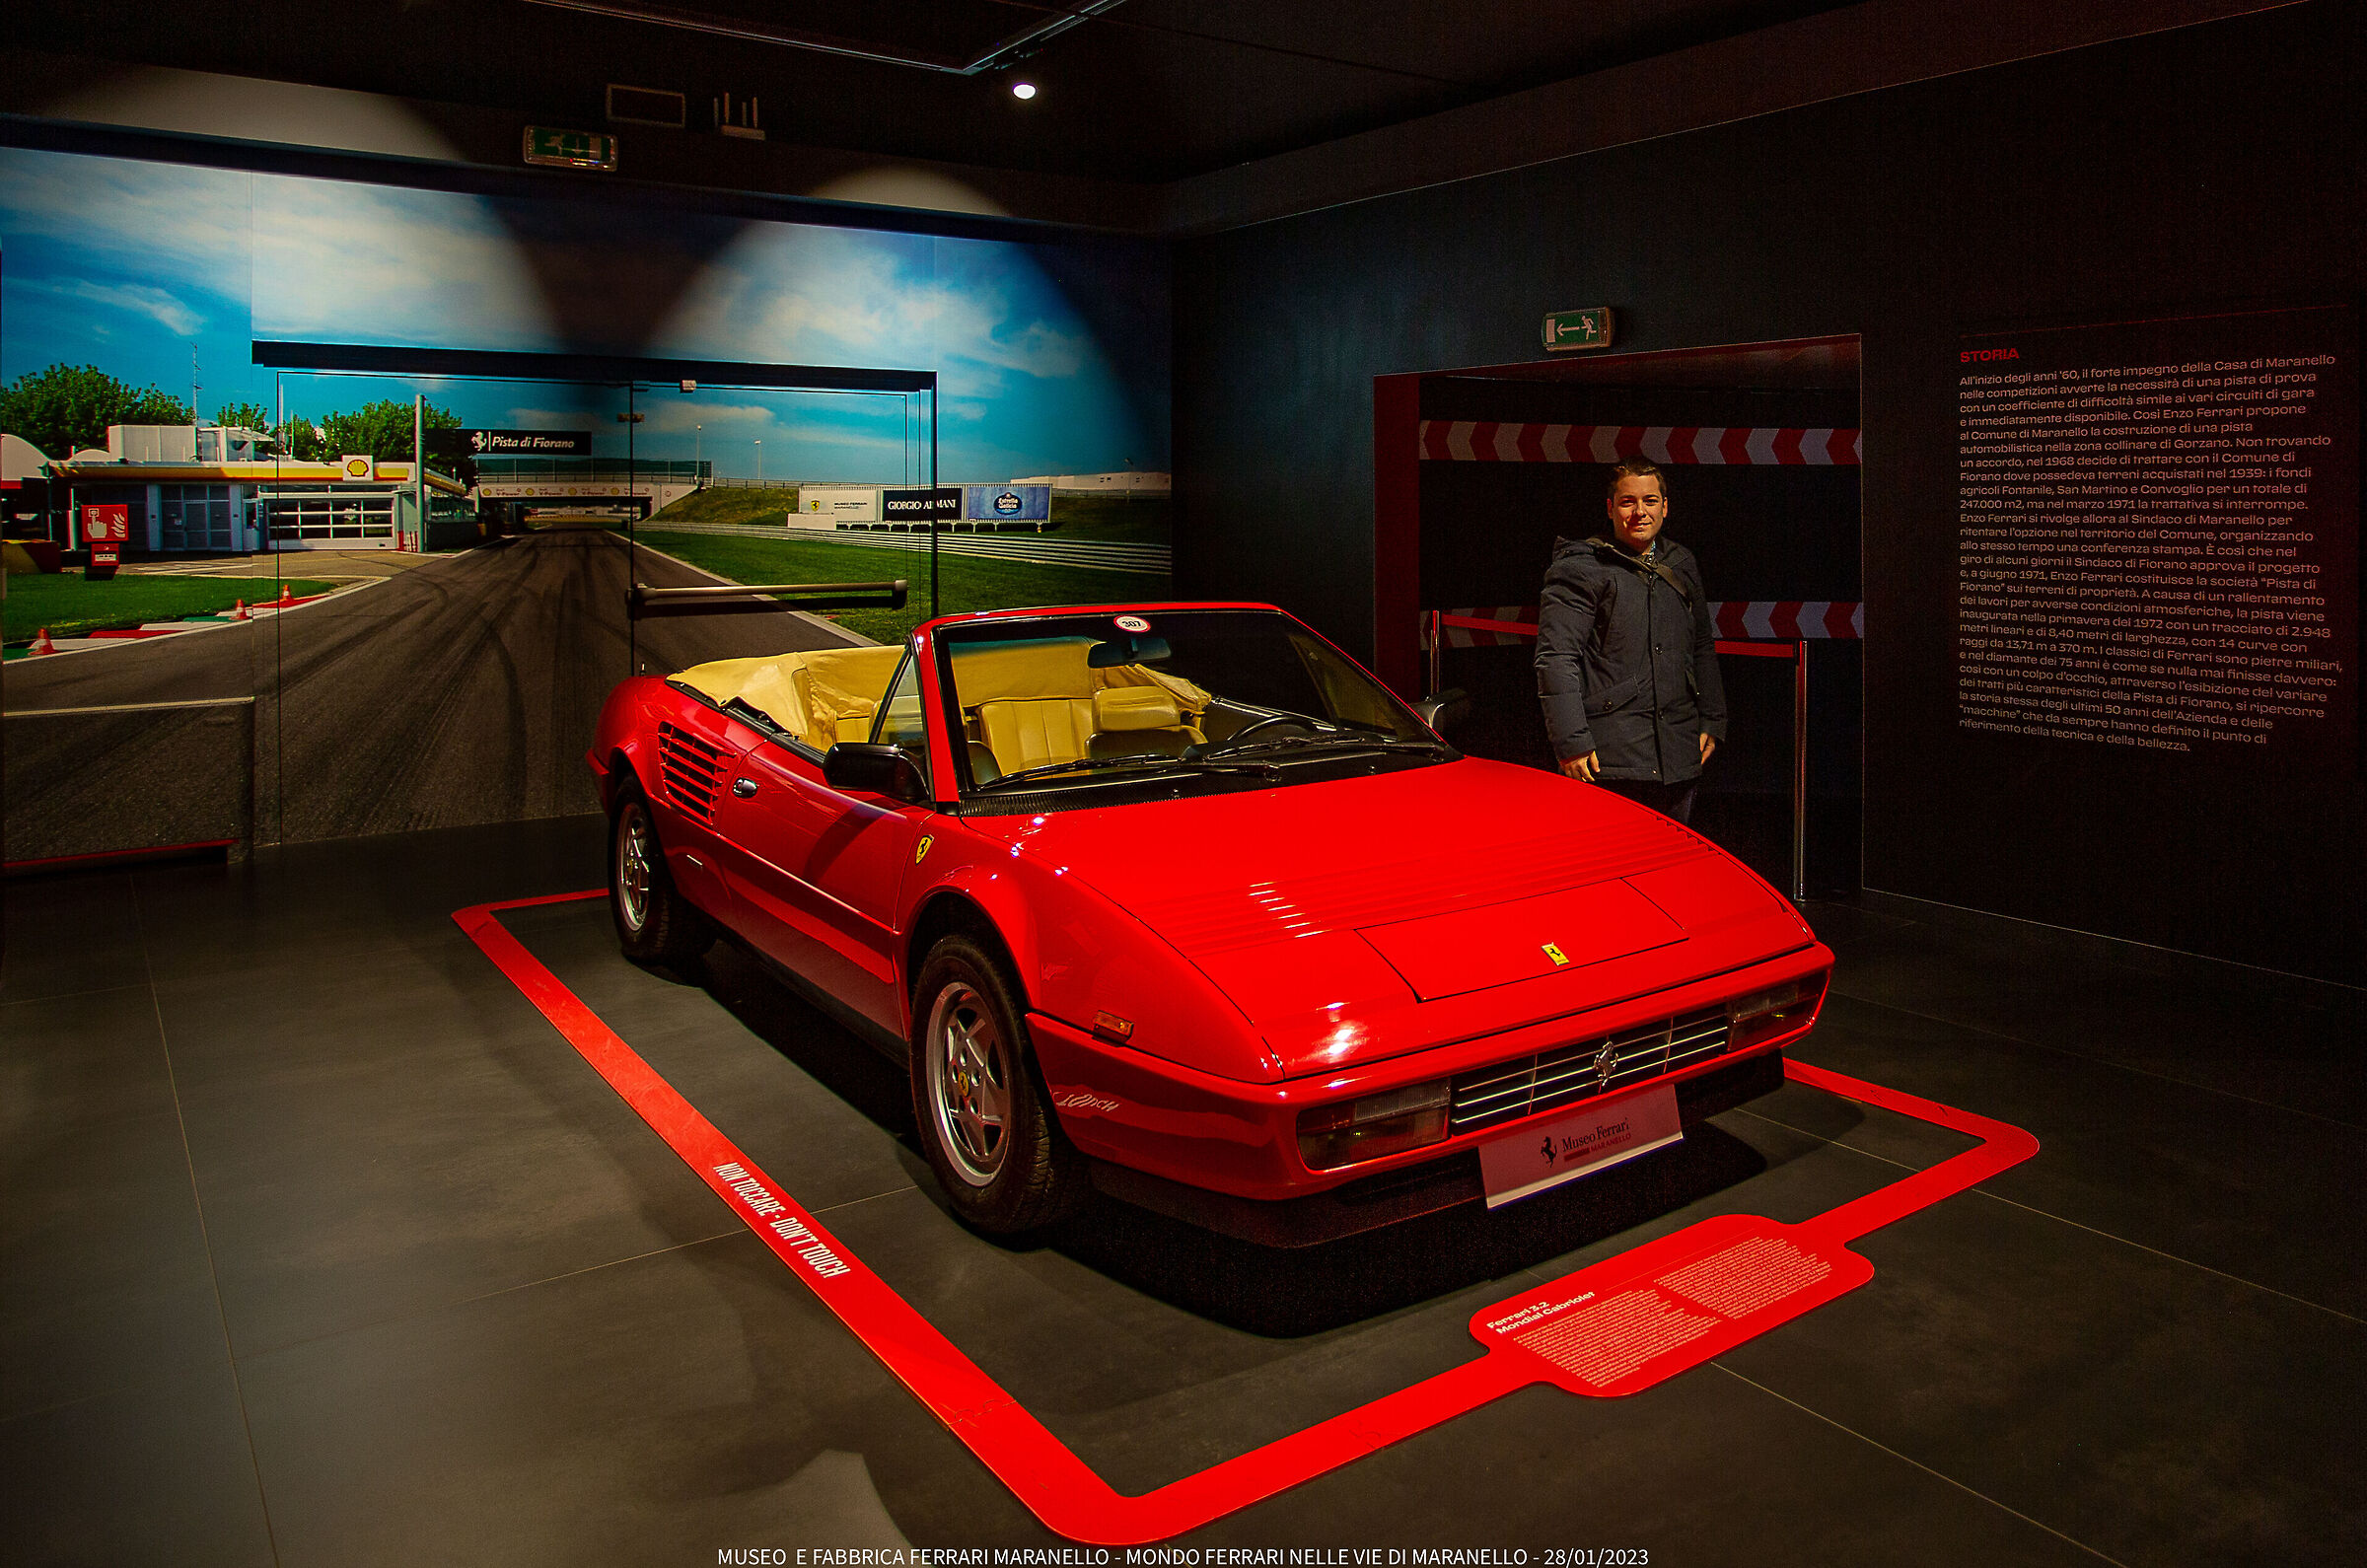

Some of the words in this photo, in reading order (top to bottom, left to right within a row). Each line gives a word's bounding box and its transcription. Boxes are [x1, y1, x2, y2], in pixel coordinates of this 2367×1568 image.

[1960, 347, 2020, 363] STORIA
[2004, 372, 2031, 385] degli
[2033, 371, 2057, 382] anni
[2082, 369, 2088, 379] il
[2091, 368, 2120, 379] forte
[2122, 365, 2179, 378] impegno
[2181, 362, 2211, 373] della
[2214, 360, 2248, 371] Casa
[2250, 358, 2262, 369] di
[2265, 354, 2335, 368] Maranello
[1960, 389, 1984, 399] nelle
[1986, 385, 2057, 399] competizioni
[2059, 384, 2105, 394] avverte
[2107, 382, 2117, 392] la
[2182, 378, 2193, 389] di
[2196, 378, 2221, 388] una
[2223, 375, 2257, 389] pista
[2259, 374, 2271, 385] di
[2274, 373, 2317, 386] prova
[1981, 403, 1996, 412] un
[1997, 399, 2065, 411] coefficiente
[2067, 397, 2078, 408] di
[2135, 393, 2173, 405] simile
[2175, 392, 2186, 403] ai
[2188, 392, 2213, 403] vari
[2215, 390, 2263, 401] circuiti
[2265, 389, 2278, 399] di
[2281, 390, 2315, 401] gara
[1969, 414, 2062, 427] immediatamente
[2063, 411, 2130, 425] disponibile.
[2163, 408, 2193, 419] Enzo
[2196, 406, 2243, 418] Ferrari
[2246, 405, 2306, 418] propone
[492, 436, 519, 448] Pista
[520, 436, 533, 448] di
[533, 437, 575, 449] Fiorano
[1960, 430, 1970, 440] al
[1971, 430, 2017, 440] Comune
[2019, 428, 2030, 439] di
[2032, 427, 2089, 438] Maranello
[2090, 426, 2101, 436] la
[2103, 424, 2177, 436] costruzione
[2179, 423, 2190, 434] di
[2193, 424, 2218, 433] una
[2220, 422, 2253, 435] pista
[1960, 443, 2043, 454] automobilistica
[2044, 442, 2071, 452] nella
[2074, 443, 2102, 452] zona
[2104, 440, 2157, 451] collinare
[2159, 439, 2171, 450] di
[2174, 439, 2233, 449] Gorzano.
[2236, 437, 2263, 448] Non
[2266, 435, 2331, 447] trovando
[1975, 457, 2025, 467] accordo,
[2026, 457, 2044, 466] nel
[2044, 456, 2075, 466] 1968
[2076, 455, 2117, 465] decide
[2118, 455, 2130, 464] di
[2133, 455, 2183, 464] trattare
[2185, 455, 2210, 463] con
[2212, 453, 2219, 463] il
[2221, 453, 2279, 463] Comune
[2282, 452, 2295, 462] di
[1960, 471, 2001, 481] Fiorano
[2003, 471, 2031, 481] dove
[2033, 470, 2096, 483] possedeva
[2098, 469, 2139, 480] terreni
[2142, 468, 2204, 481] acquistati
[2206, 468, 2226, 478] nel
[2229, 467, 2266, 478] 1939:
[2268, 467, 2272, 477] i
[2275, 466, 2312, 477] fondi
[1960, 485, 2000, 497] agricoli
[2002, 484, 2054, 496] Fontanile,
[2056, 484, 2079, 494] San
[2081, 484, 2128, 494] Martino
[2140, 484, 2204, 496] Convoglio
[2206, 486, 2231, 496] per
[2232, 485, 2250, 494] un
[2253, 483, 2291, 494] totale
[2294, 483, 2307, 494] di
[888, 500, 922, 510] GIORGIO
[1959, 690, 1969, 700] la
[1970, 692, 2001, 703] storia
[2003, 695, 2039, 707] stessa
[2041, 697, 2068, 711] degli
[2070, 701, 2103, 713] ultimi
[2105, 703, 2121, 715] 50
[2122, 707, 2149, 718] anni
[2230, 717, 2239, 726] e
[2241, 716, 2273, 729] delle
[1959, 718, 2021, 734] riferimento
[2023, 724, 2049, 737] della
[2051, 728, 2094, 742] tecnica
[2096, 734, 2104, 743] e
[2106, 733, 2134, 746] della
[2137, 736, 2189, 751] bellezza.
[2022, 711, 2044, 722] che
[2044, 712, 2060, 724] da
[2062, 716, 2109, 730] sempre
[2111, 719, 2149, 733] hanno
[2151, 723, 2200, 738] definito
[2202, 728, 2209, 739] il
[2212, 731, 2252, 743] punto
[2254, 733, 2266, 745] di
[1561, 1132, 1596, 1153] Museo
[1596, 1116, 1630, 1141] Ferrari
[713, 1162, 751, 1182] NON
[730, 1177, 786, 1217] TOCCARE
[769, 1216, 820, 1247] DON'T
[797, 1243, 851, 1279] TOUCH
[1486, 1308, 1532, 1329] Ferrari
[1529, 1301, 1550, 1313] 3.2
[1495, 1312, 1544, 1334] Mondial
[1542, 1291, 1596, 1316] Cabriolet
